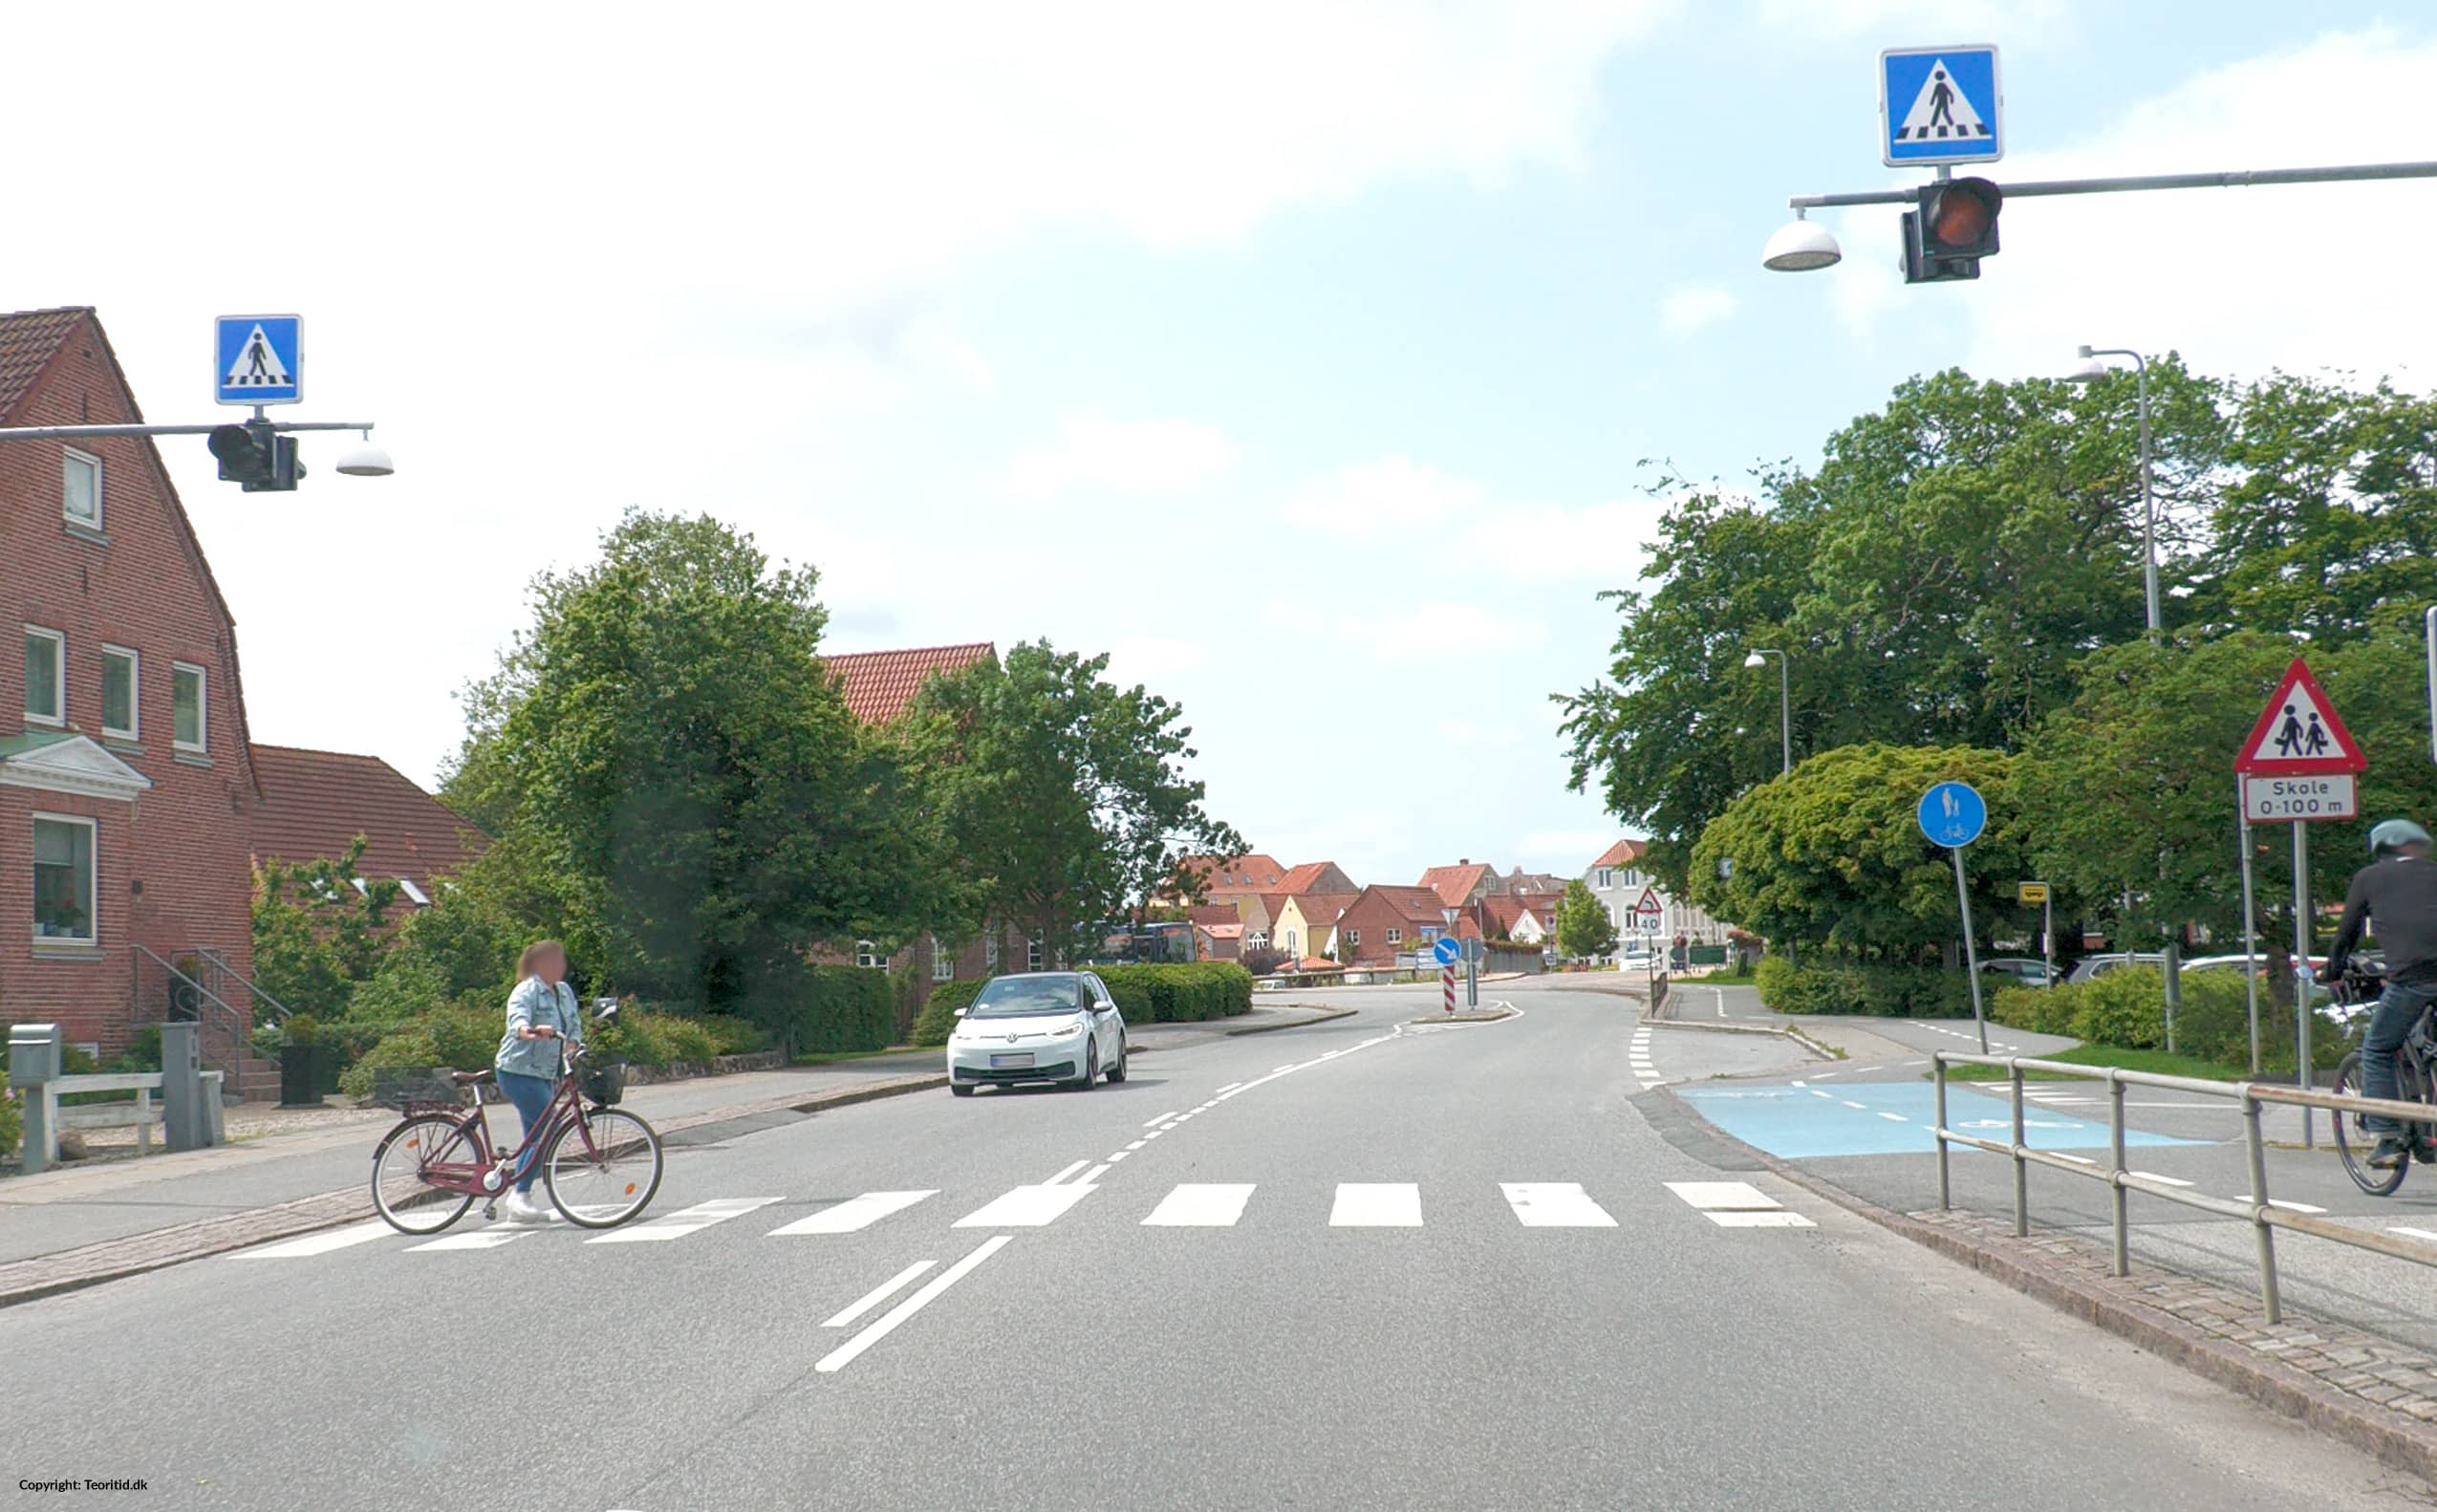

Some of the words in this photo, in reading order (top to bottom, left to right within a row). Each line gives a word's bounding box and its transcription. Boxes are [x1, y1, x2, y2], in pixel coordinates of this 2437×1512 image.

[2273, 781, 2329, 795] Skole
[2260, 799, 2319, 814] 0-100
[2328, 801, 2342, 811] m
[1641, 918, 1658, 929] 40
